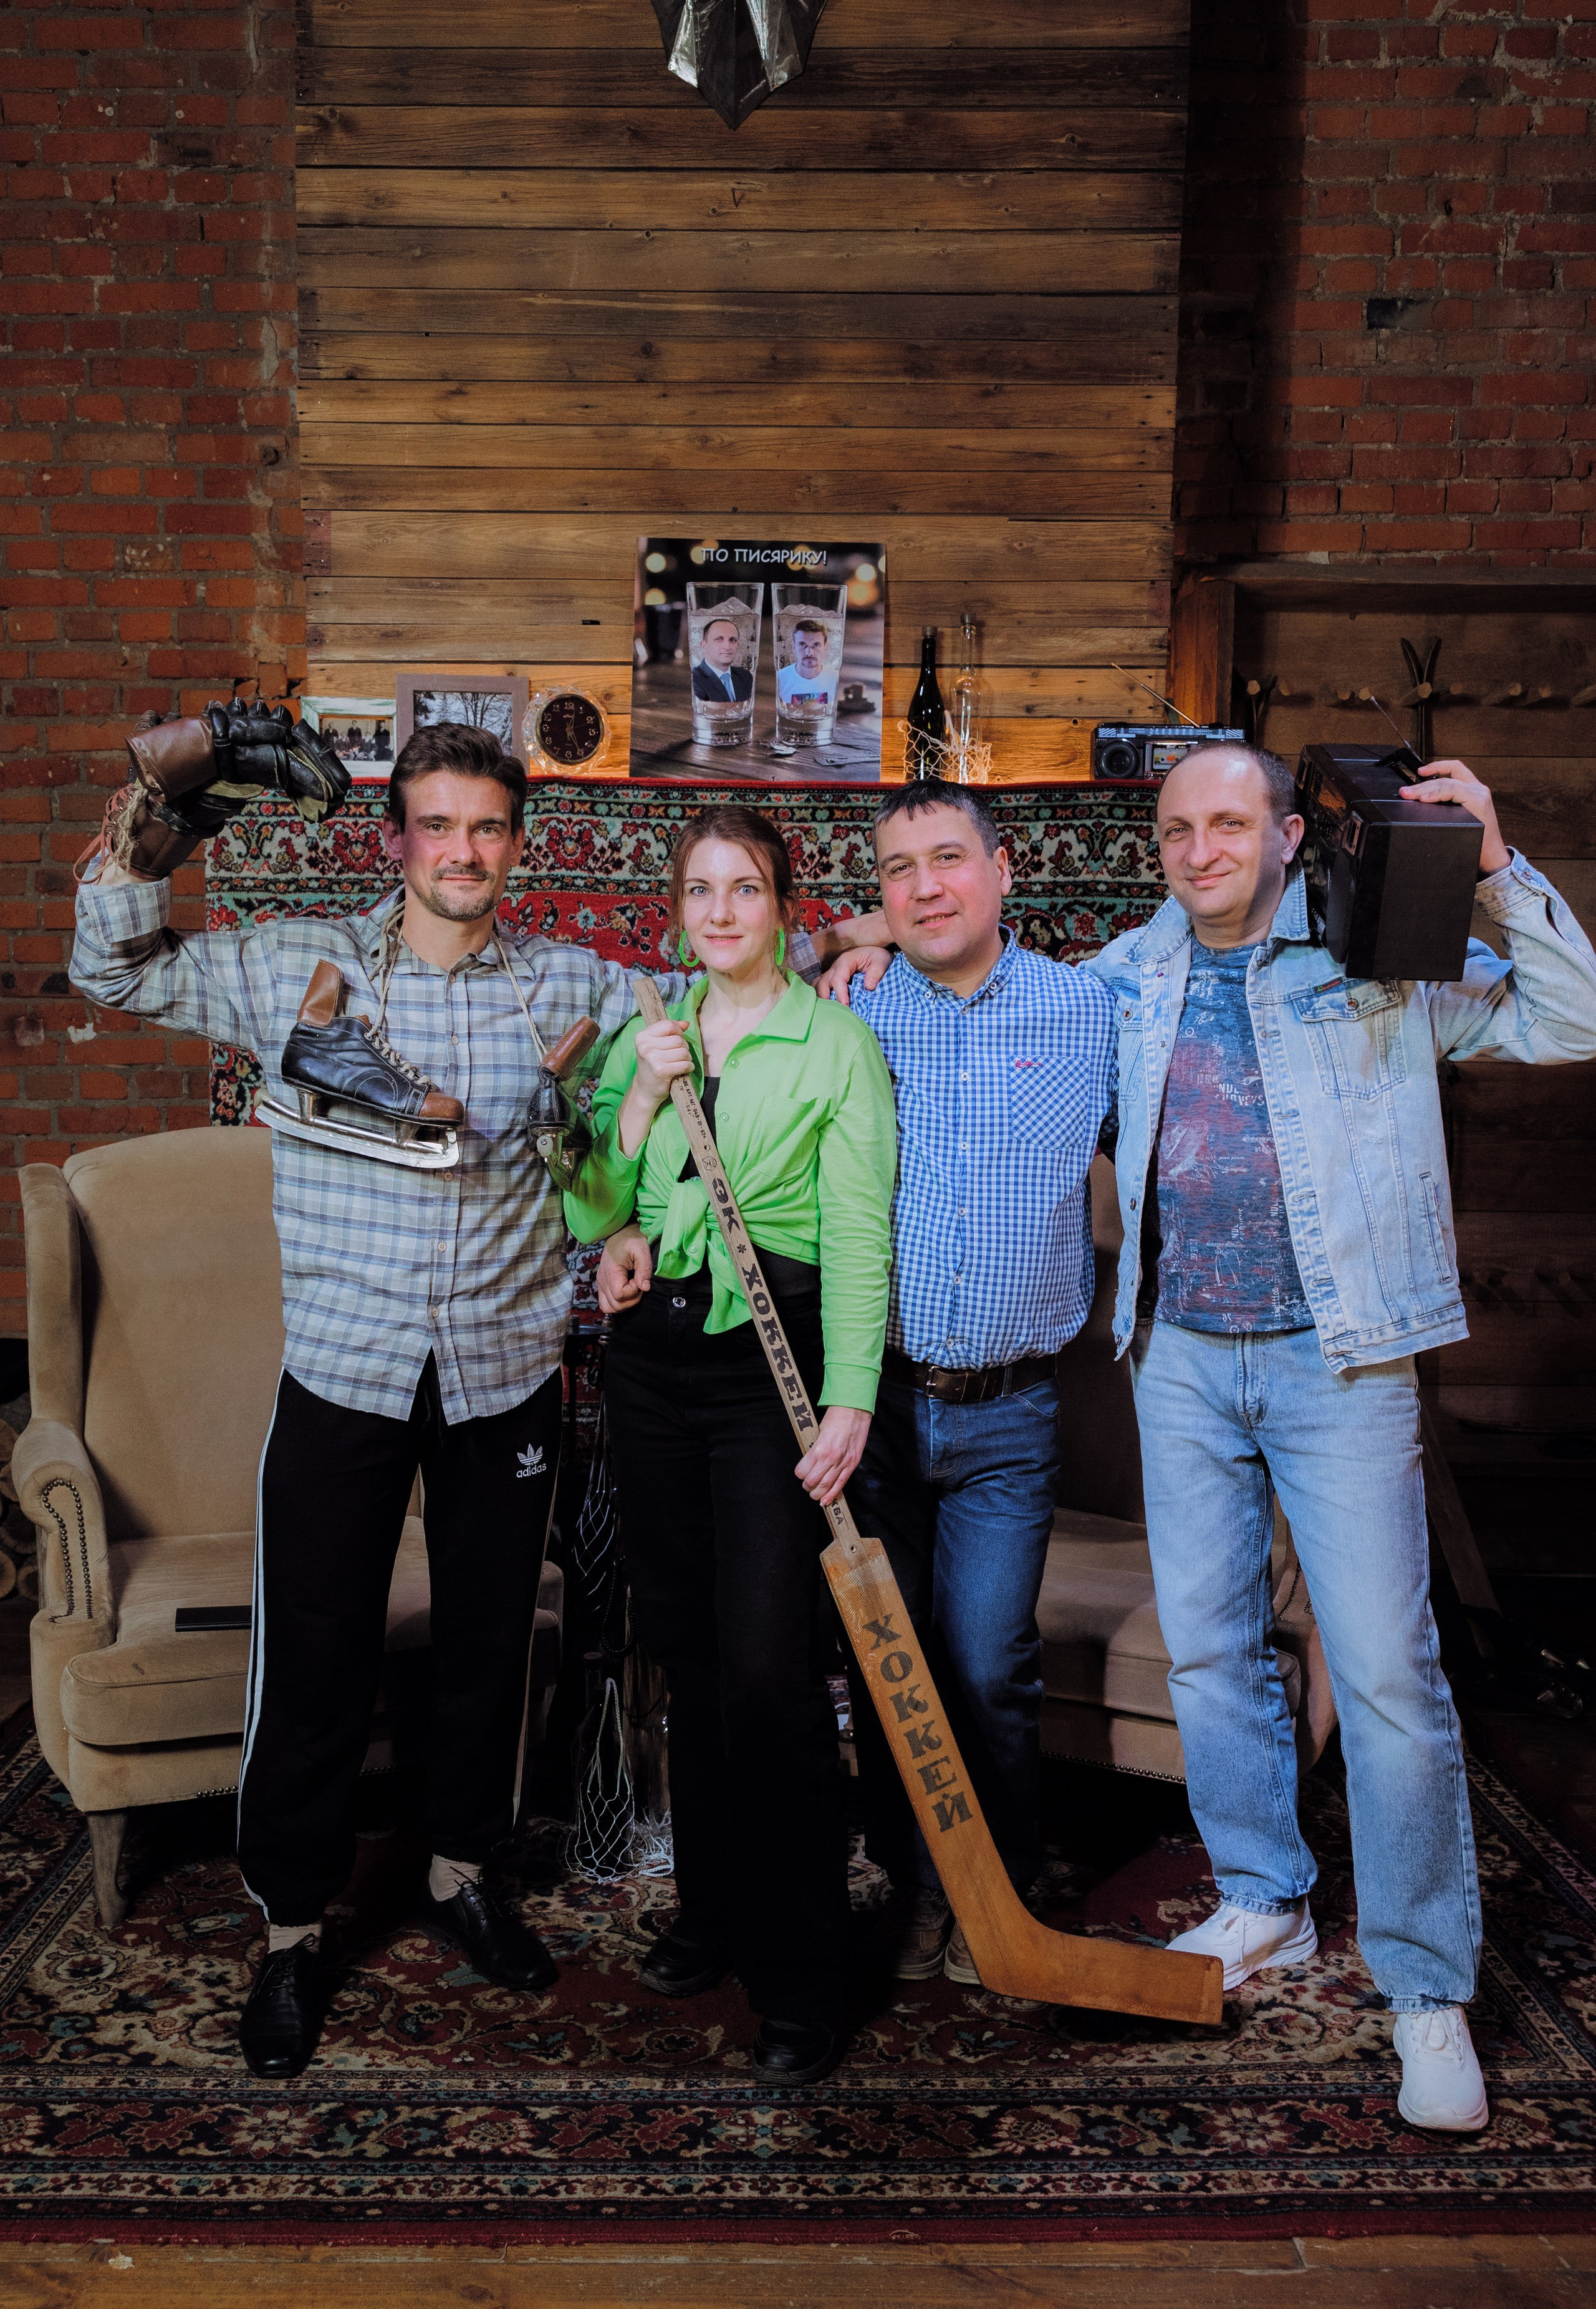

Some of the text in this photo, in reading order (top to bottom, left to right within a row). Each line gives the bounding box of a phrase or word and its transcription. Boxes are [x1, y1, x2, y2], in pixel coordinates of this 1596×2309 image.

[701, 547, 827, 566] ПО ПИСЯРИКУ!
[741, 1263, 814, 1432] ХОККЕЙ
[516, 1463, 547, 1478] adidas
[862, 1613, 973, 1833] ХОККЕЙ
